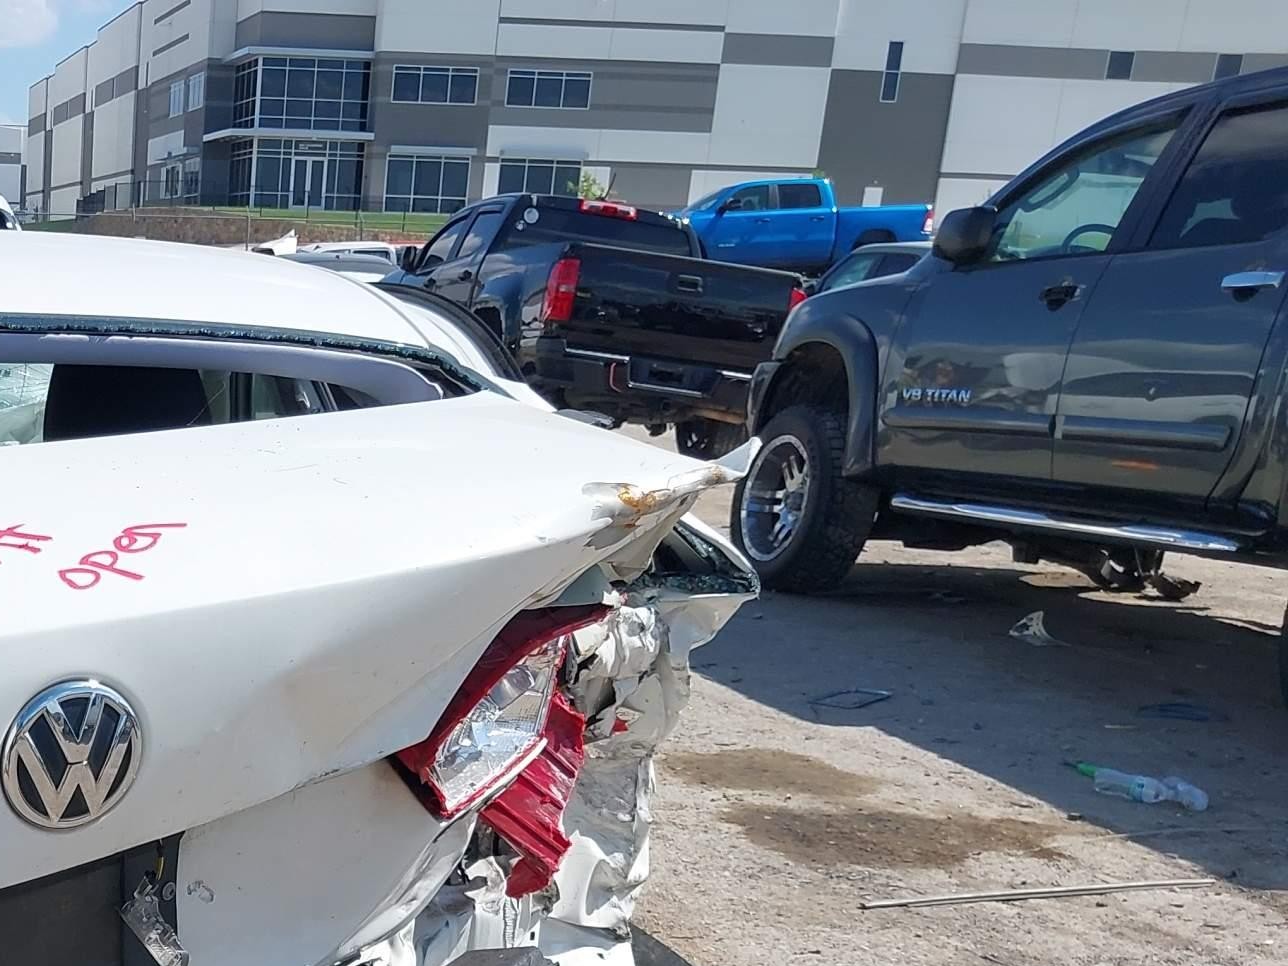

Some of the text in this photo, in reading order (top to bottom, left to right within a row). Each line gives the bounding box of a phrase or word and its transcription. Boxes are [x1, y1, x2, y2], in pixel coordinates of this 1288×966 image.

[925, 388, 972, 403] TITAN
[58, 523, 188, 589] open
[12, 690, 136, 825] VW
